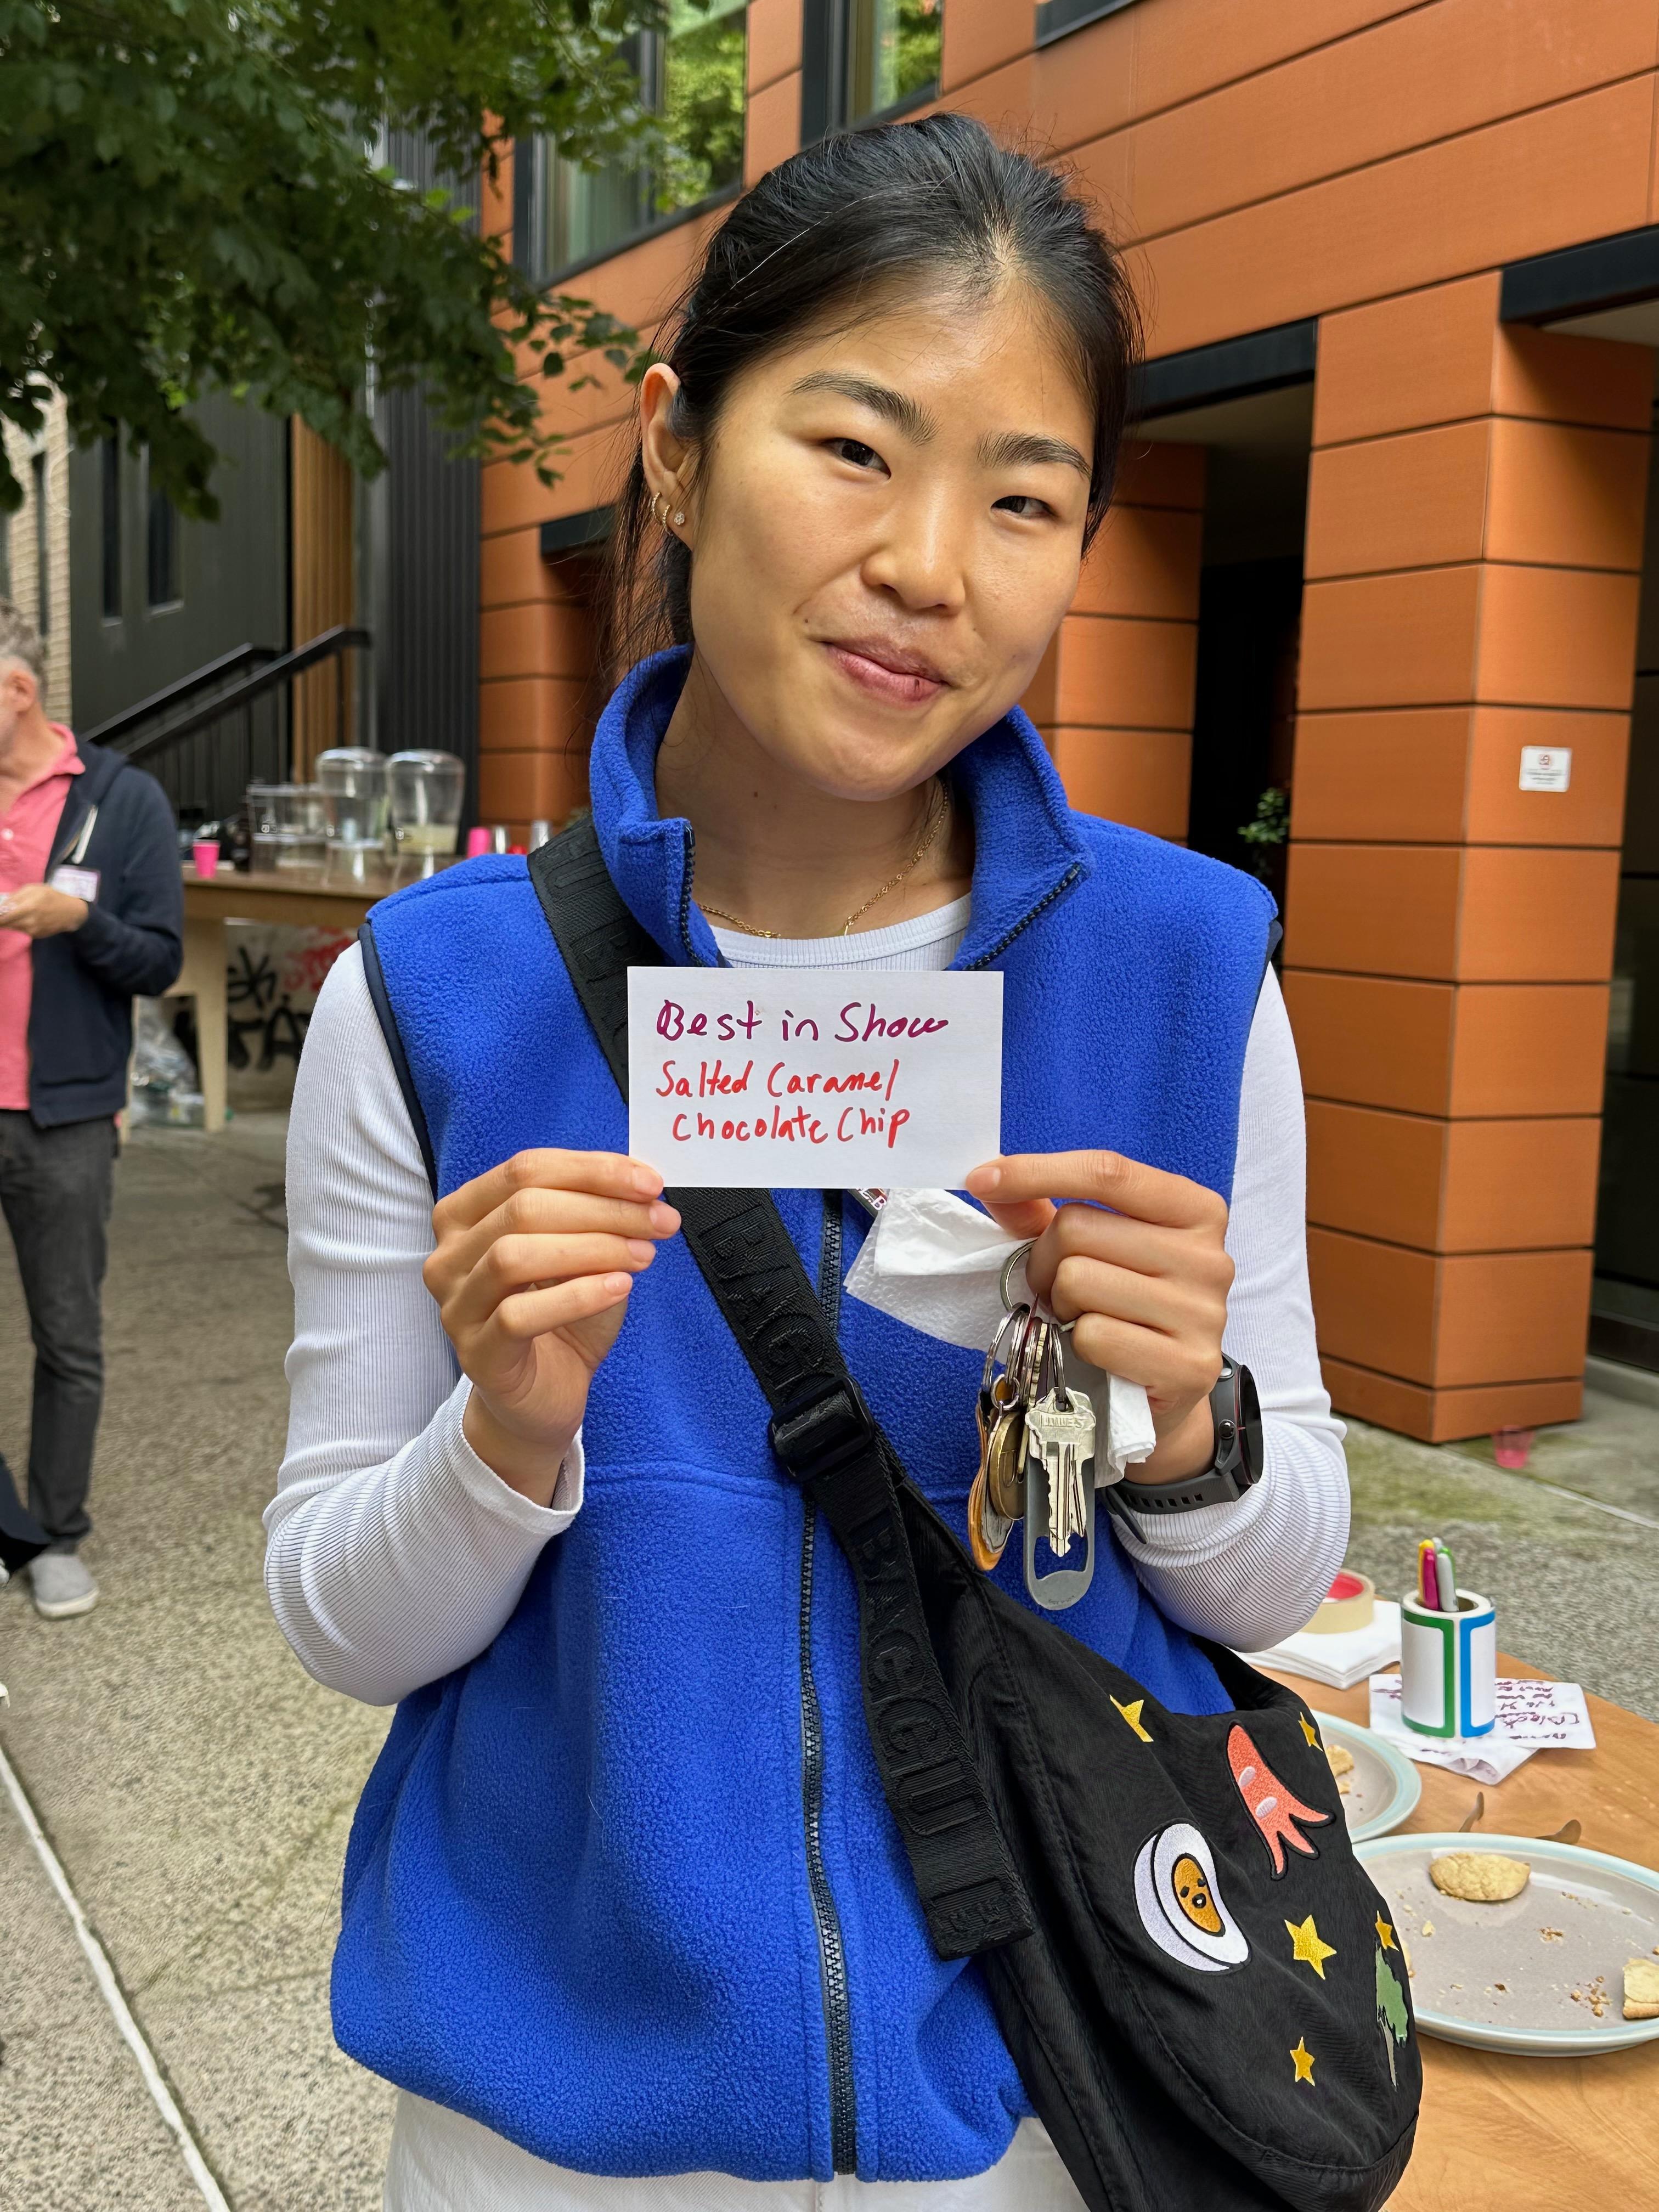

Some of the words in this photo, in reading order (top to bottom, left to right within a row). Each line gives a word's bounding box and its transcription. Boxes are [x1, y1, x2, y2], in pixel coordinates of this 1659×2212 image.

[656, 1000, 763, 1041] Best
[781, 1009, 819, 1041] in
[834, 1002, 949, 1042] Show
[656, 1059, 754, 1098] Salted
[766, 1058, 900, 1102] Caramel
[837, 1106, 911, 1148] Chip
